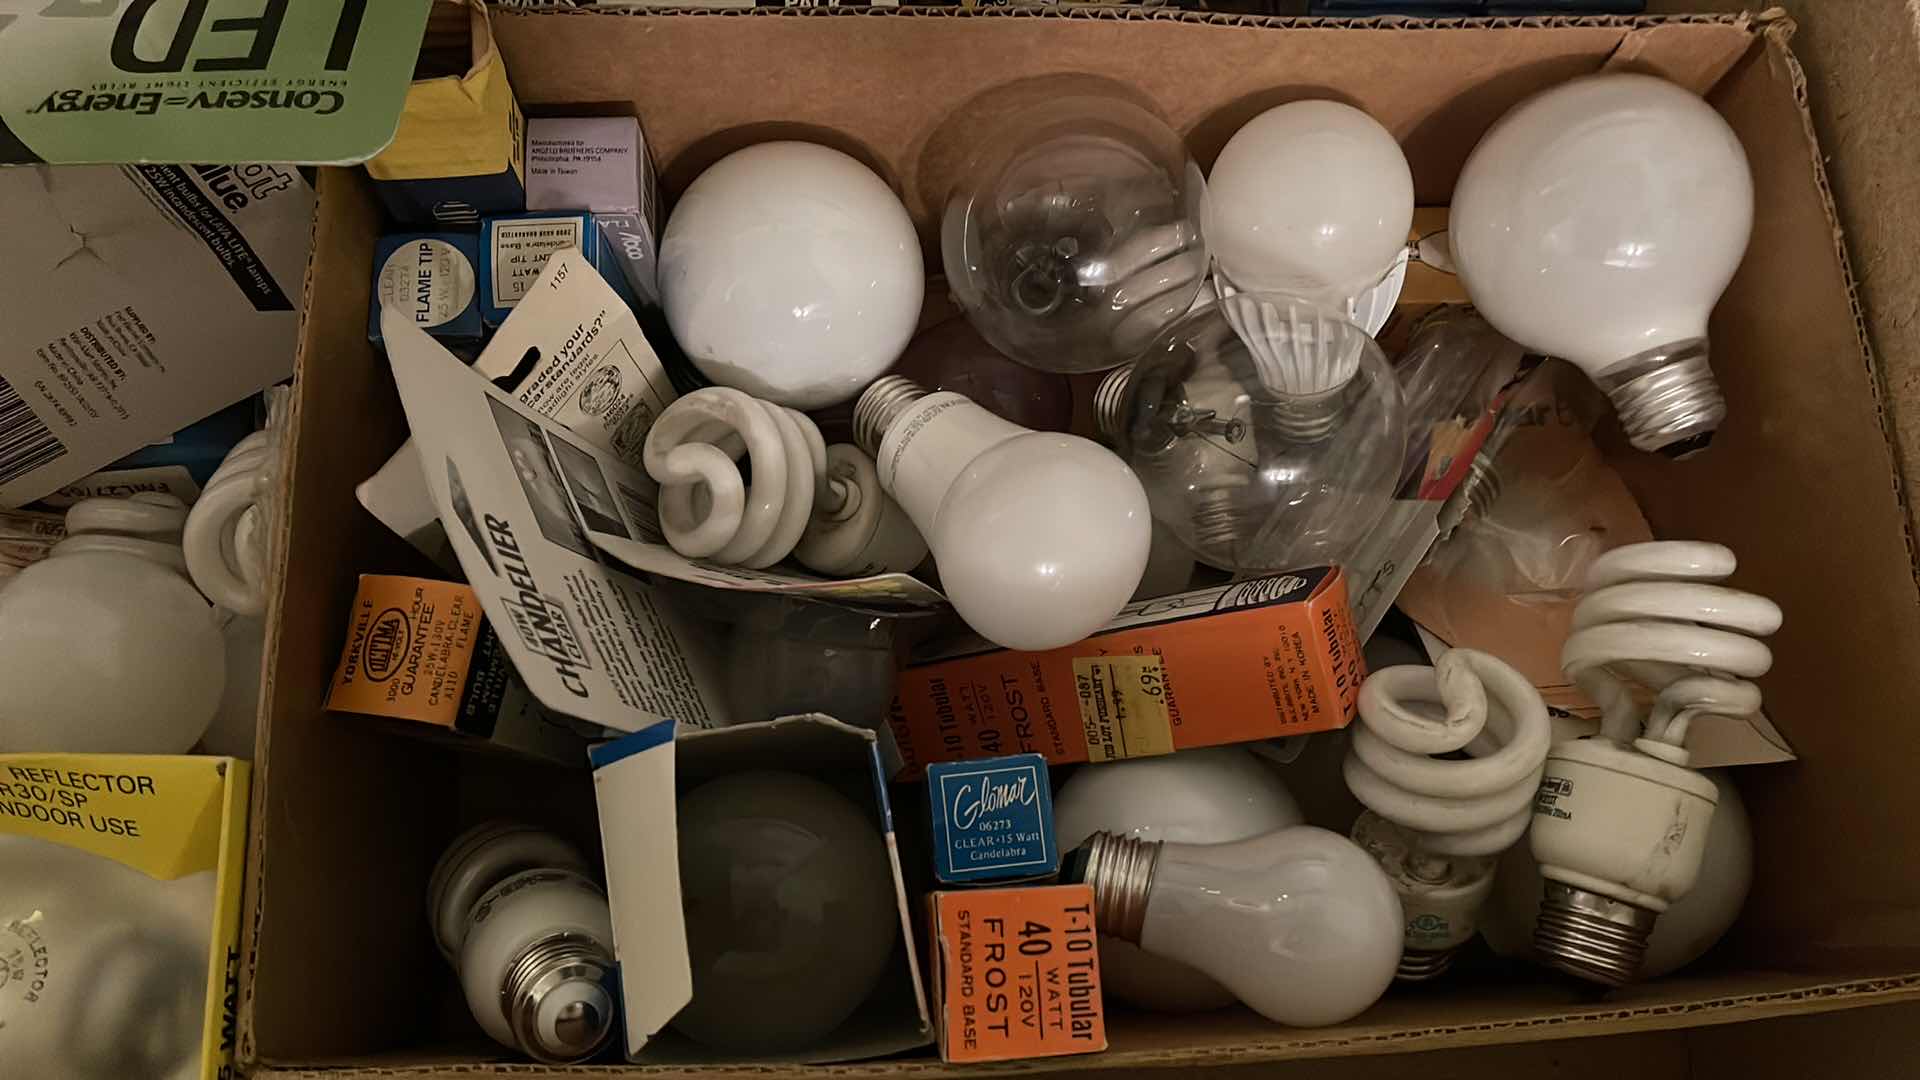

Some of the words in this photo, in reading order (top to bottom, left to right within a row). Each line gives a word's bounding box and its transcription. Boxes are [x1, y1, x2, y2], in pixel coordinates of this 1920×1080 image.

[418, 243, 433, 271] TIP
[510, 255, 528, 263] TIP
[512, 268, 540, 277] WATT
[550, 263, 568, 290] 1157
[416, 272, 432, 322] FLAME
[517, 354, 562, 404] graded
[559, 323, 586, 356] your
[484, 513, 589, 698] CHANDELIER
[343, 599, 374, 686] YORKVILLE
[401, 602, 436, 695] GUARANTEE
[551, 610, 583, 661] CLEAR
[1321, 608, 1344, 662] Tubular
[927, 676, 957, 729] Tubular
[1000, 674, 1038, 755] FROST
[976, 727, 1001, 752] 40
[8, 766, 155, 795] REFLECTOR
[953, 775, 1036, 831] Glomar
[90, 814, 140, 837] USE
[979, 818, 1012, 832] 06273
[970, 846, 1027, 861] Candelabra
[957, 909, 978, 998] STANDARD
[1018, 920, 1052, 956] 40
[1063, 903, 1092, 953] T-10
[219, 945, 240, 1052] WATT
[983, 917, 1009, 1039] FROST
[1018, 973, 1036, 1029] 120V
[1045, 966, 1064, 1031] WATT
[1066, 957, 1098, 1041] Tubular
[962, 1005, 978, 1051] BASE
